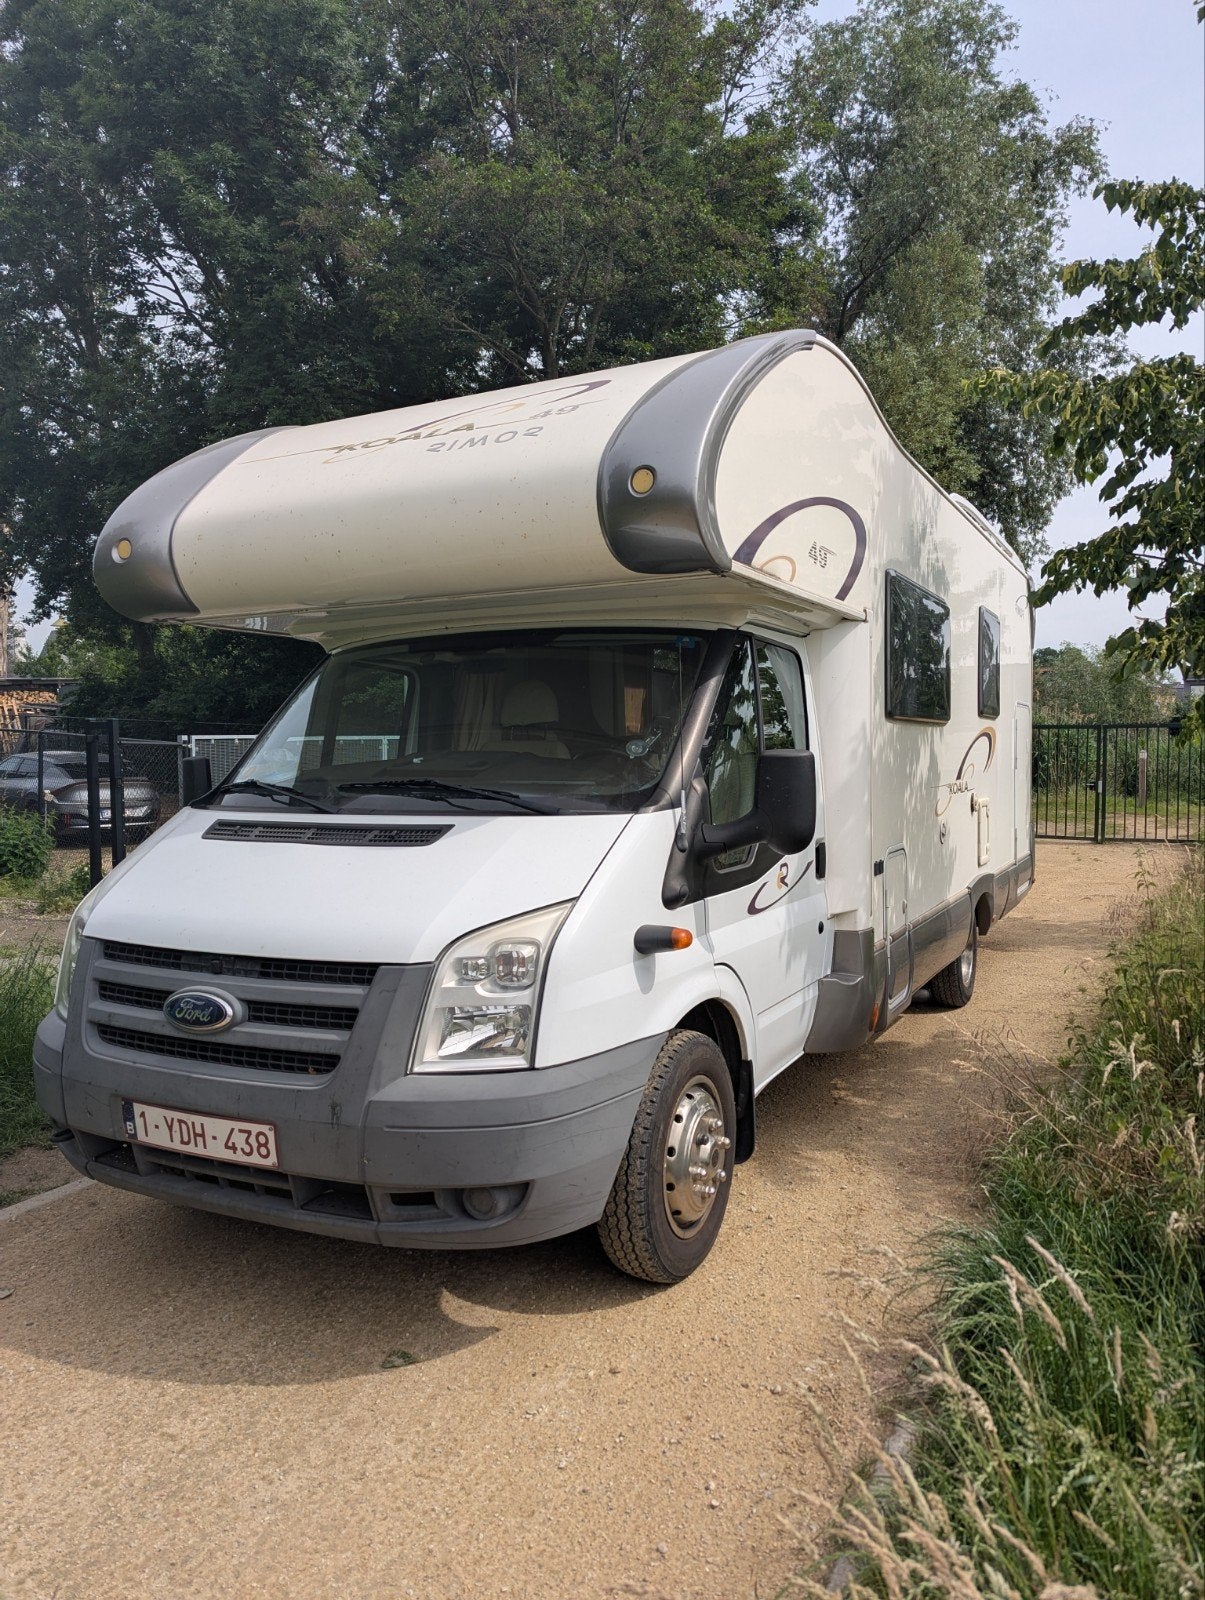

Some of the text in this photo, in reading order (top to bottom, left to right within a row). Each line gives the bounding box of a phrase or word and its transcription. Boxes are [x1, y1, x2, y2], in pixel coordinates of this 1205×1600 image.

[326, 422, 475, 454] KOALA
[175, 998, 213, 1022] Ford
[126, 1110, 272, 1160] B 1-YDH-438
